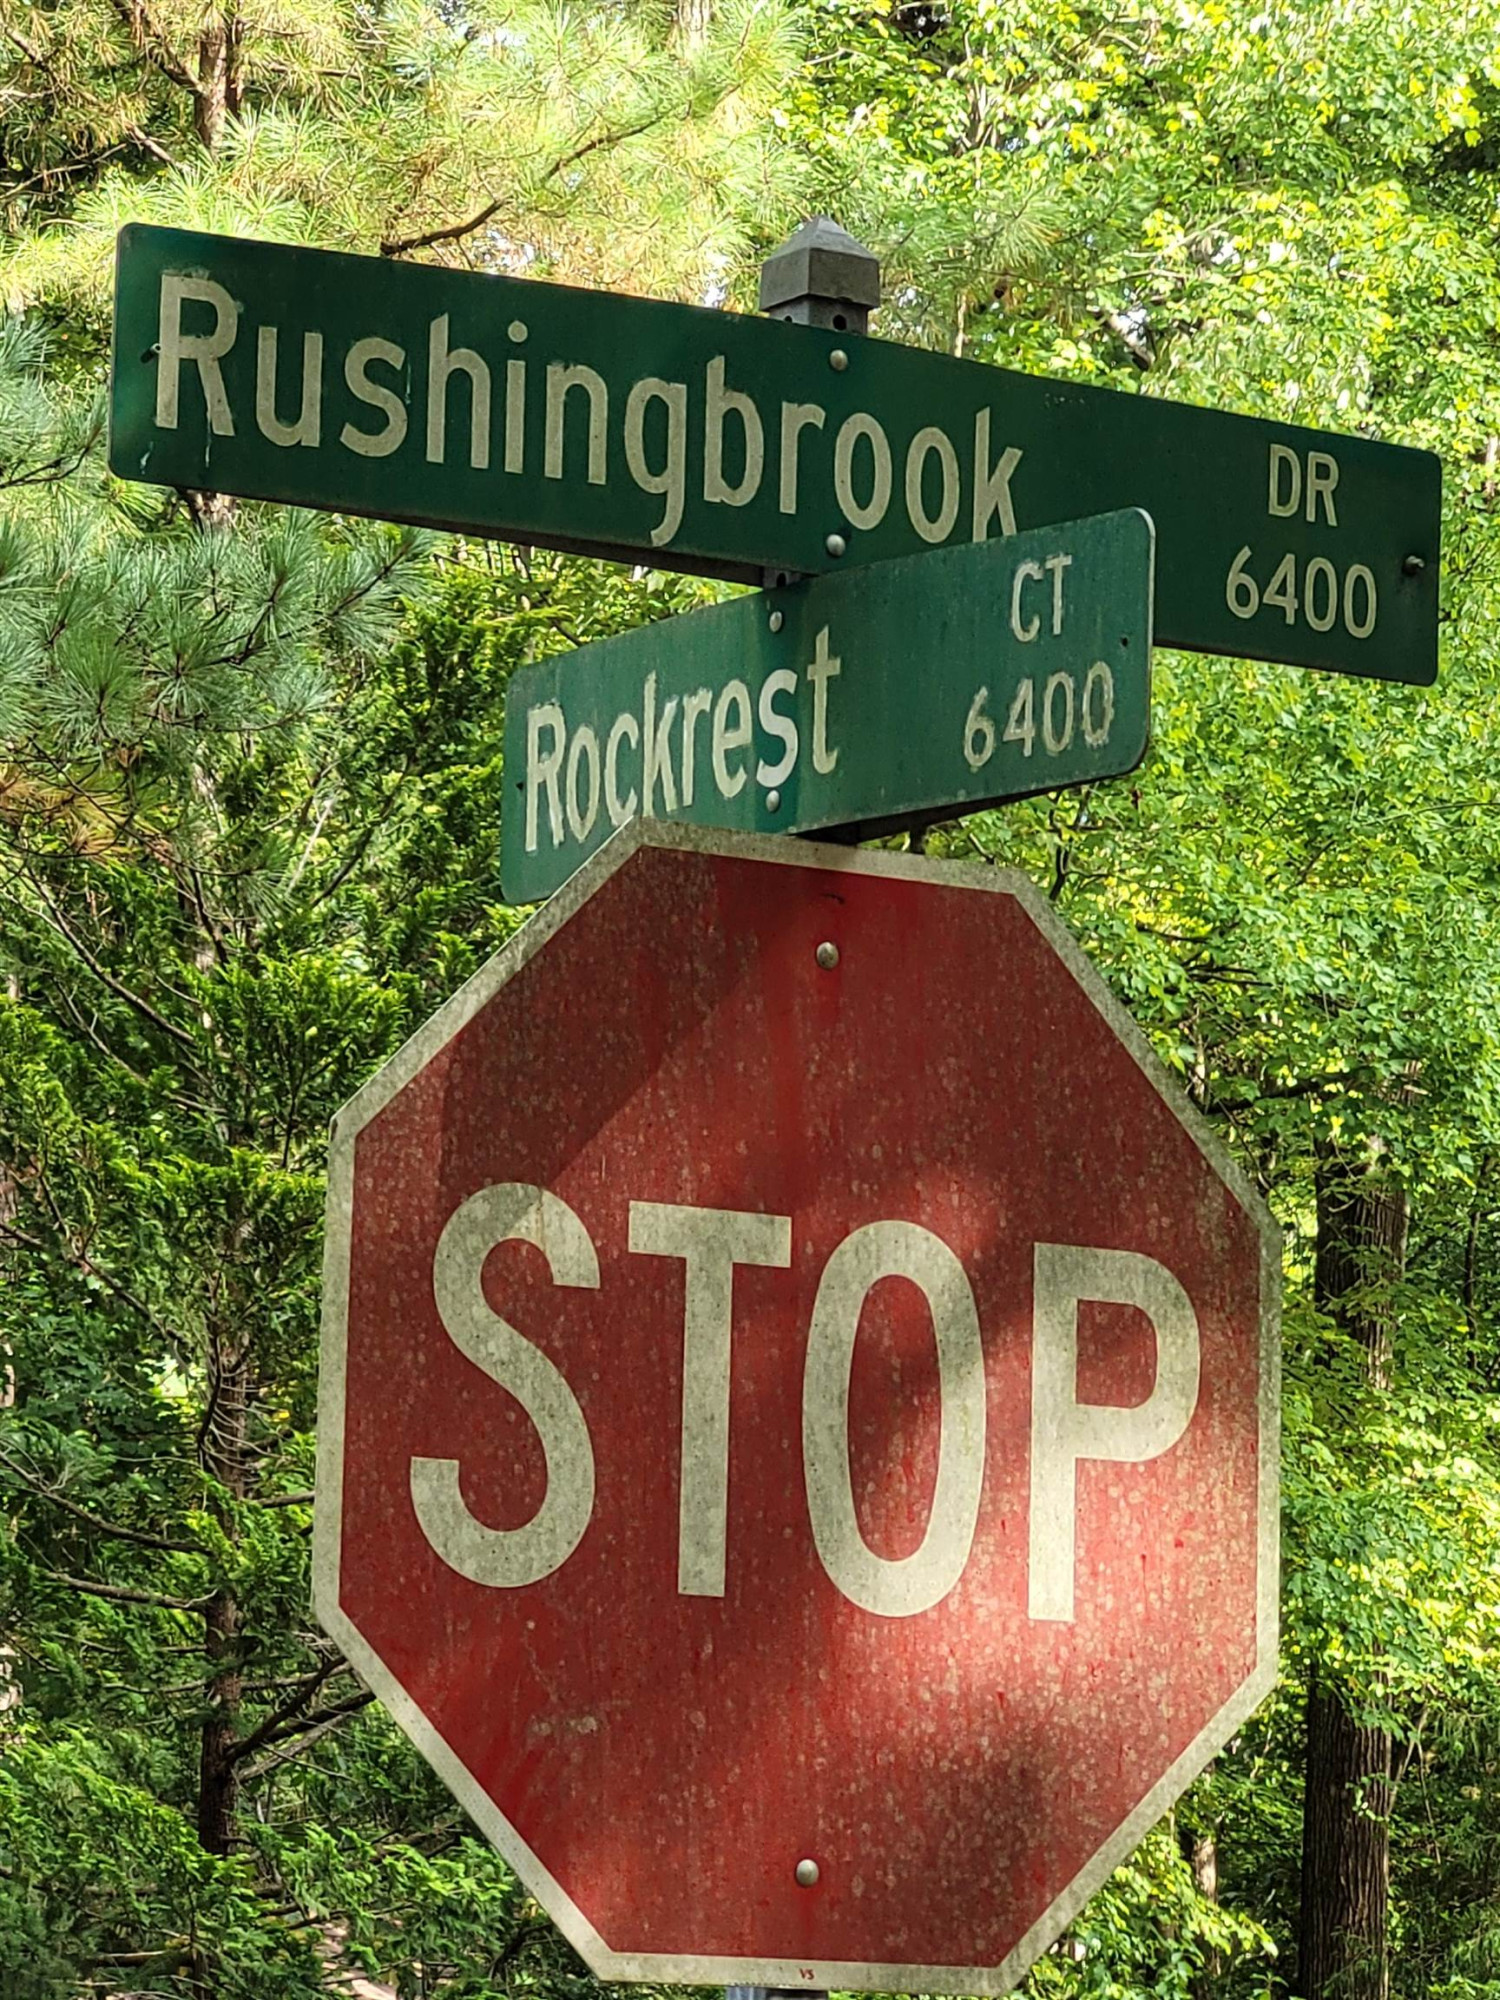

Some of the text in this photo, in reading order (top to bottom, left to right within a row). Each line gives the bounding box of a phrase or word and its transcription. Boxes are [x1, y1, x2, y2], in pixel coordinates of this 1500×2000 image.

[156, 273, 1023, 547] Rushingbrook
[1268, 444, 1340, 528] DR
[1011, 553, 1073, 642] CT
[1226, 546, 1377, 640] 6400
[525, 625, 841, 852] Rockrest
[964, 661, 1115, 772] 6400
[410, 1182, 1200, 1622] STOP
